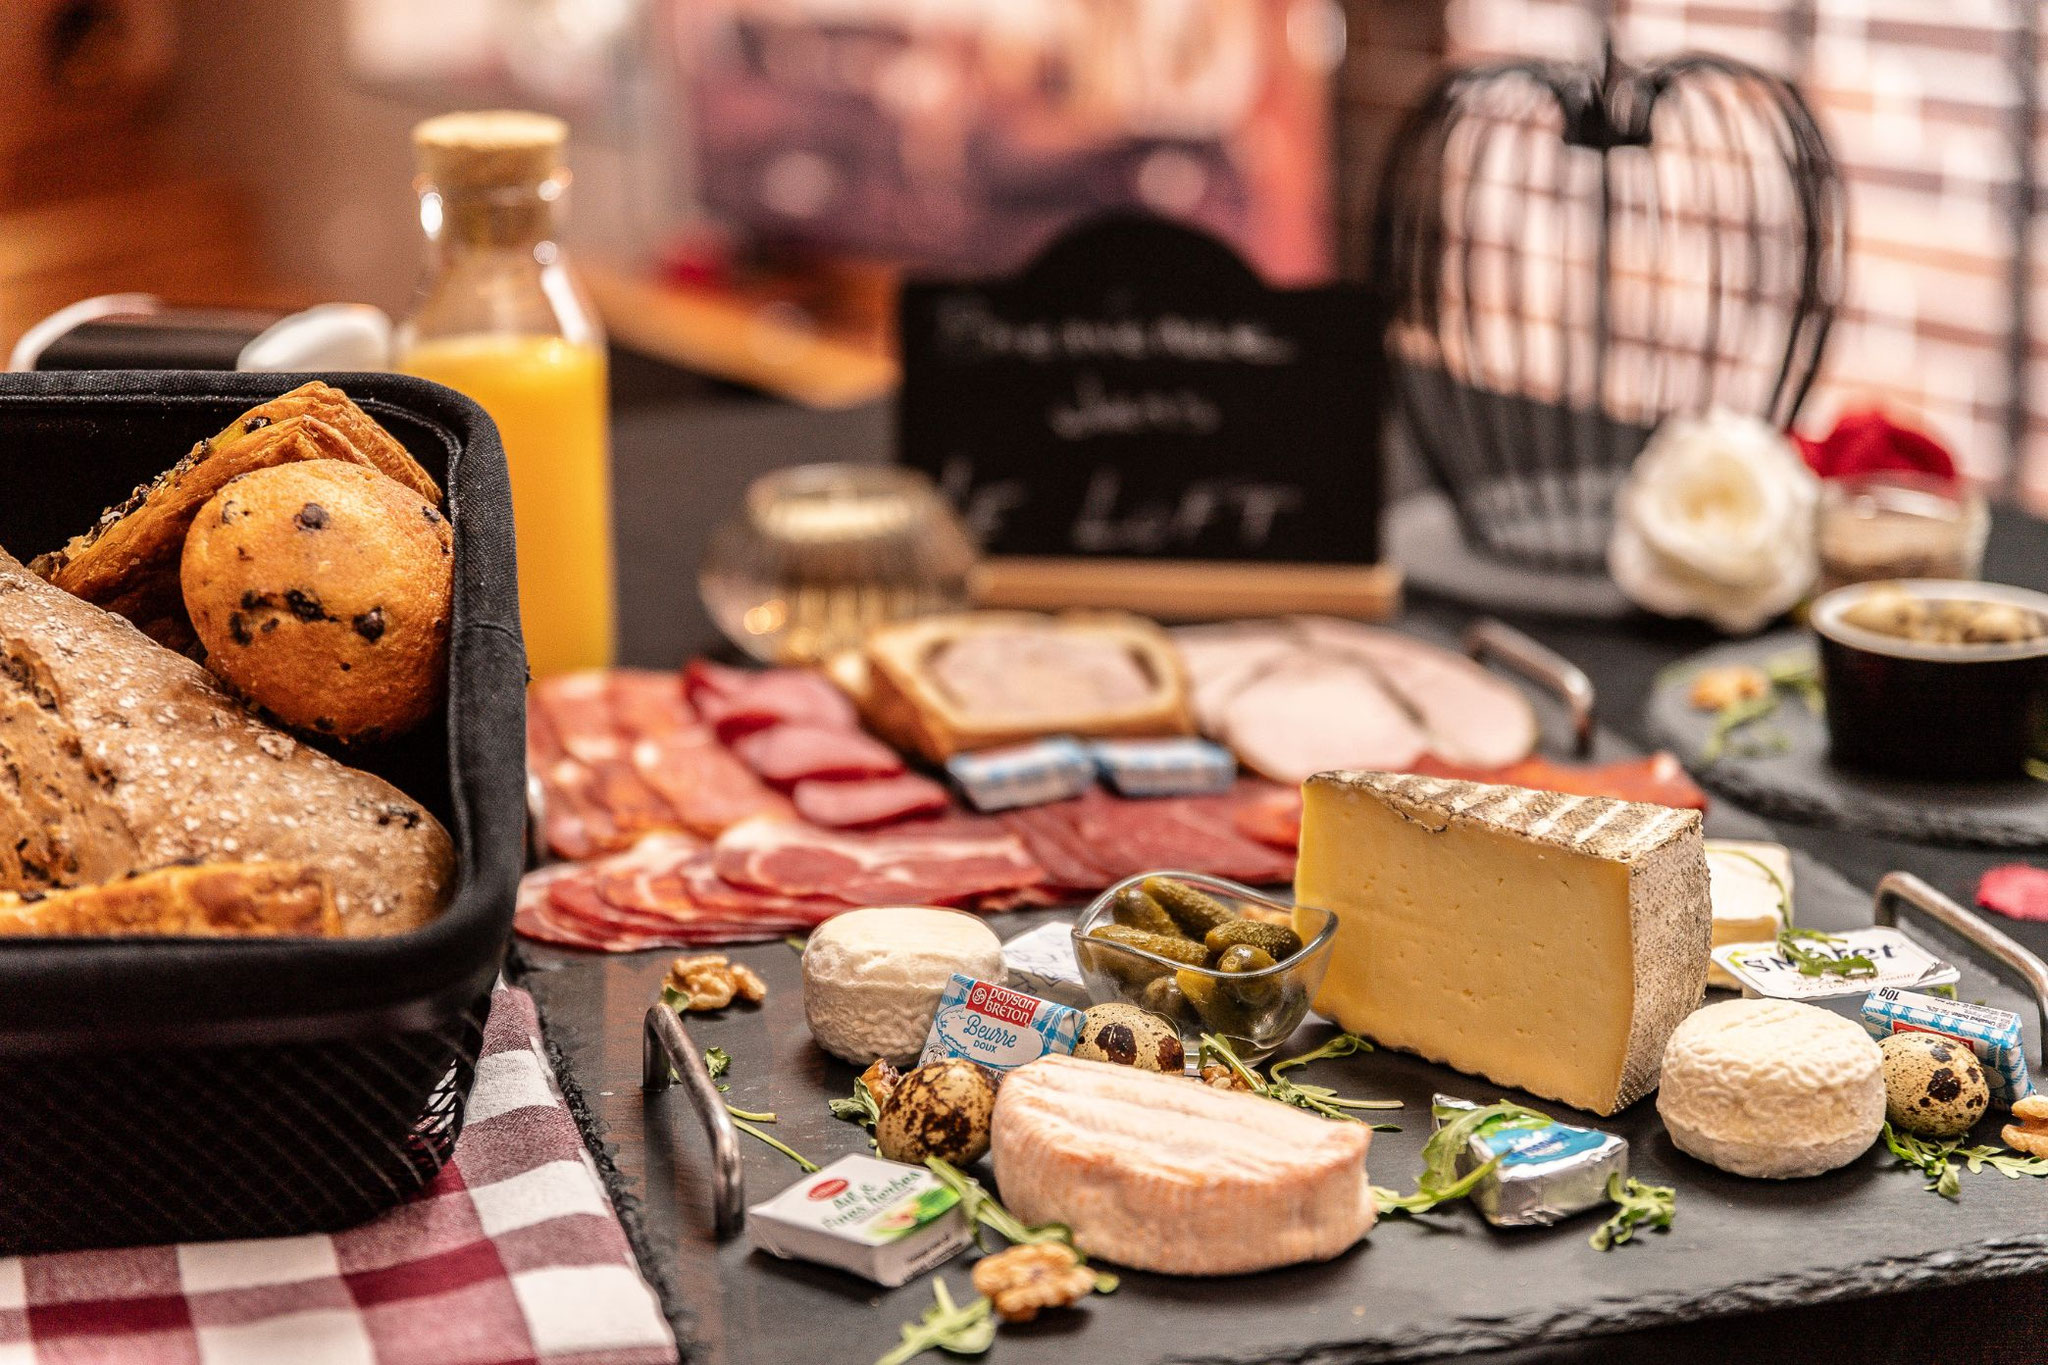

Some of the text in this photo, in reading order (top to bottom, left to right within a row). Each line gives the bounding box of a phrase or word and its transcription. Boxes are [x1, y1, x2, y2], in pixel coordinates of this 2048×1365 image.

[1879, 986, 1900, 1002] 10g
[963, 1014, 1017, 1048] Beurre
[973, 1040, 998, 1054] DOUX
